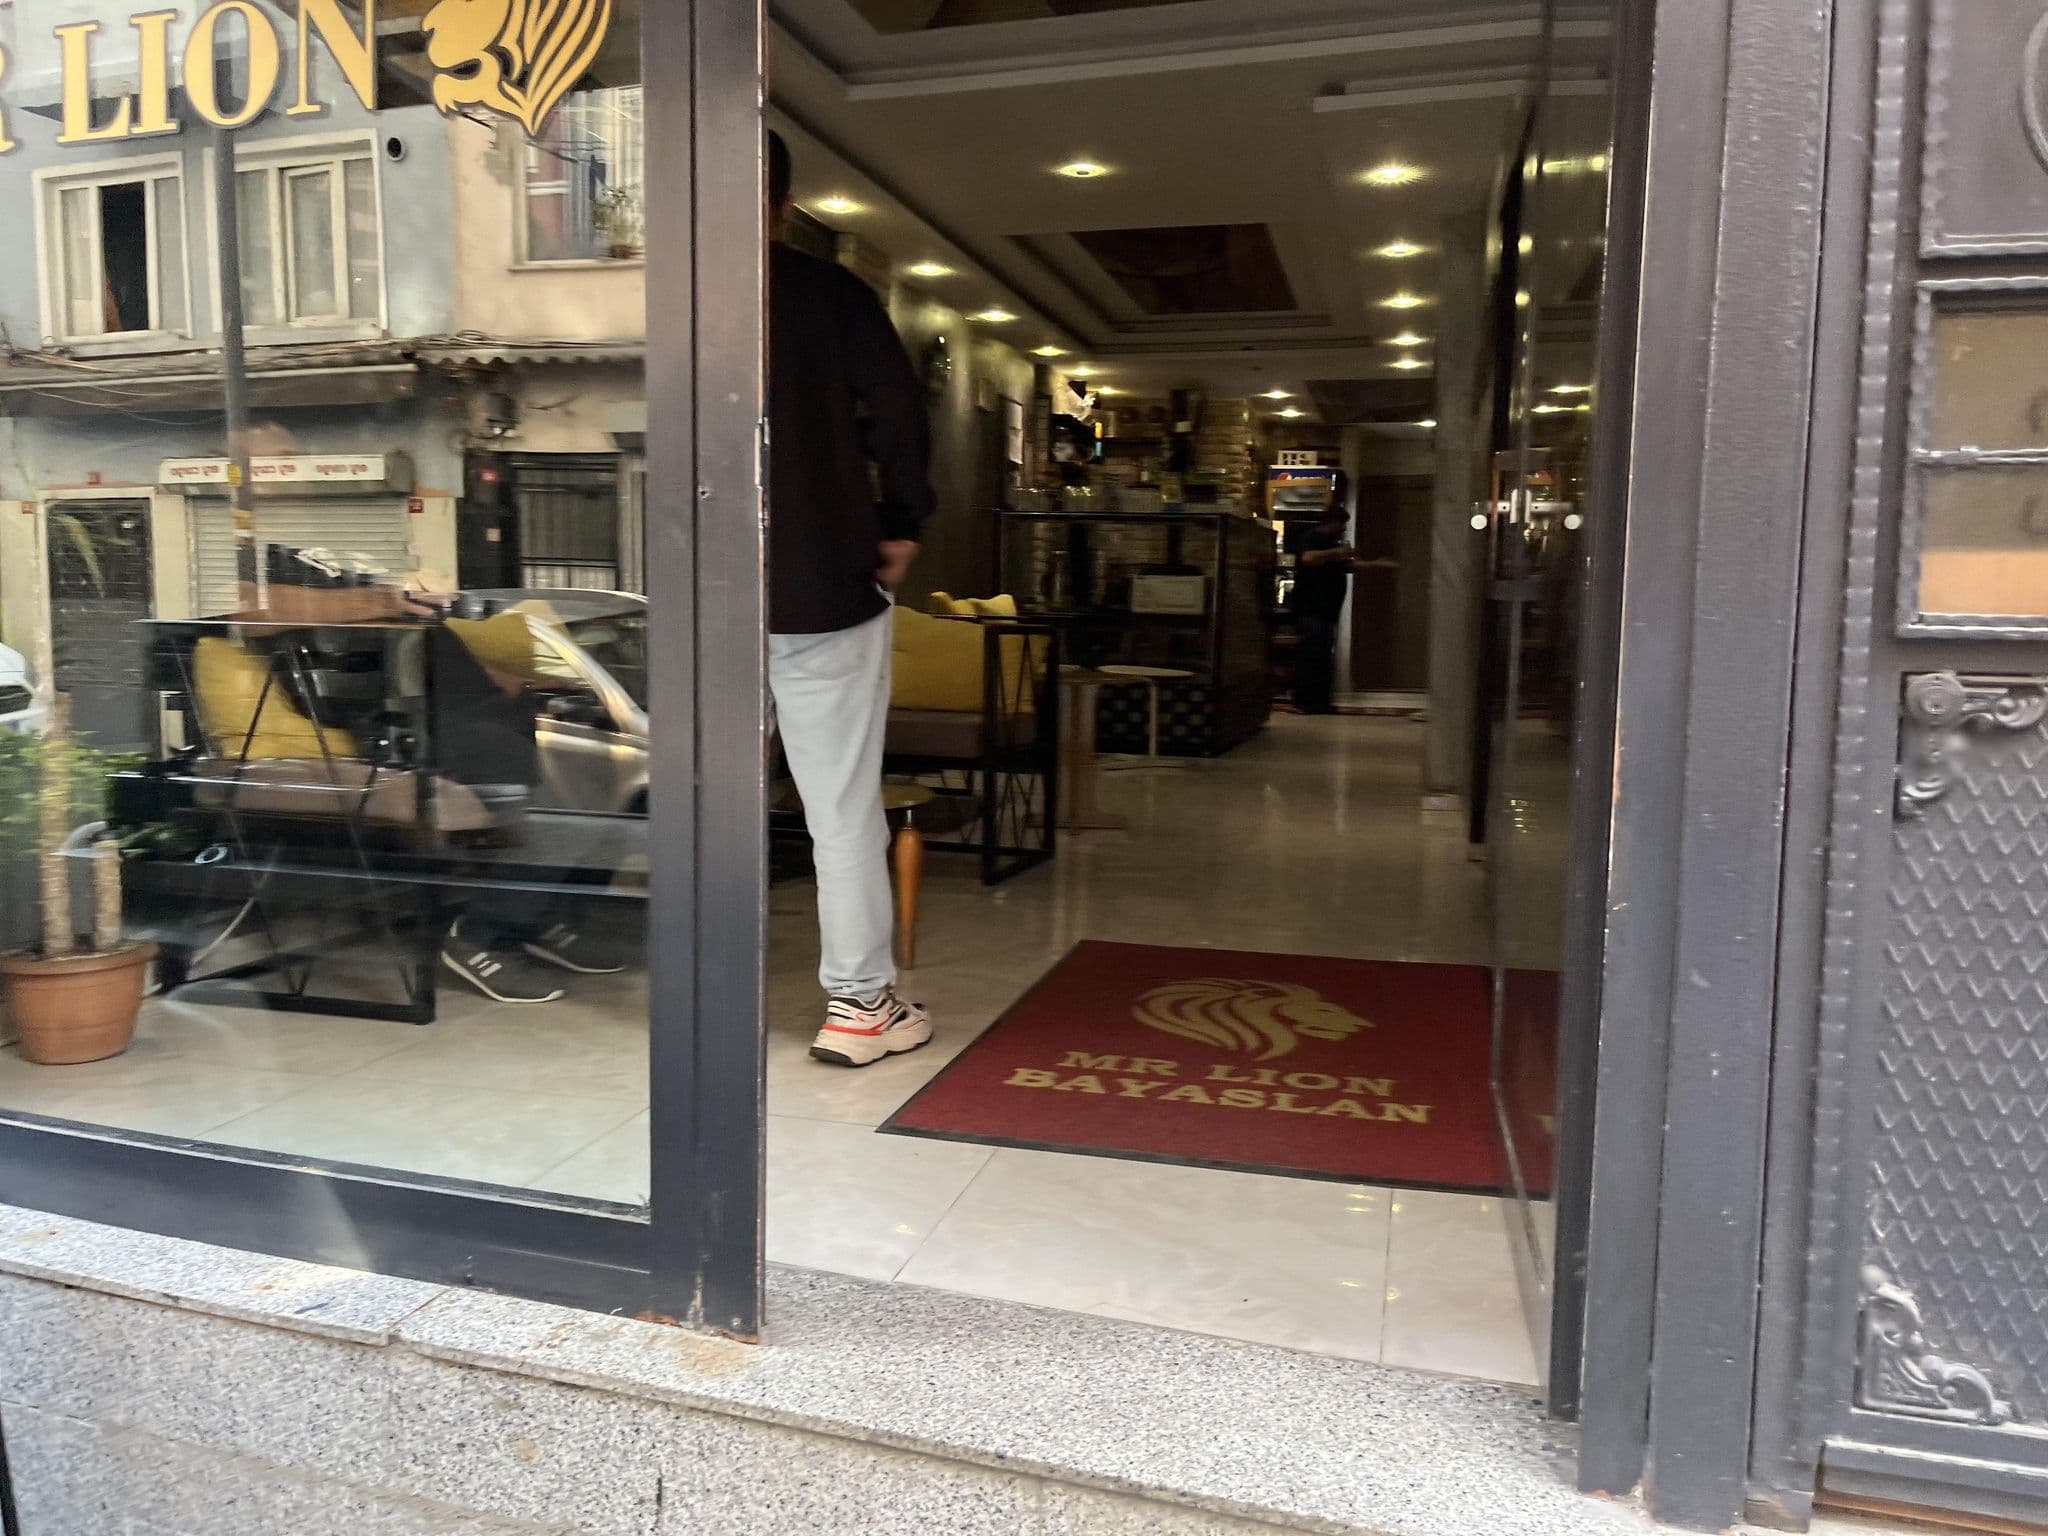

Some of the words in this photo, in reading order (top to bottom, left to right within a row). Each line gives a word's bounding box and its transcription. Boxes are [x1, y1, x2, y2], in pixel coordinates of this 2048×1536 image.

[55, 0, 376, 145] LION
[1003, 1068, 1437, 1125] BAYASLAN
[1056, 1050, 1181, 1078] MR
[1205, 1063, 1399, 1097] LION
